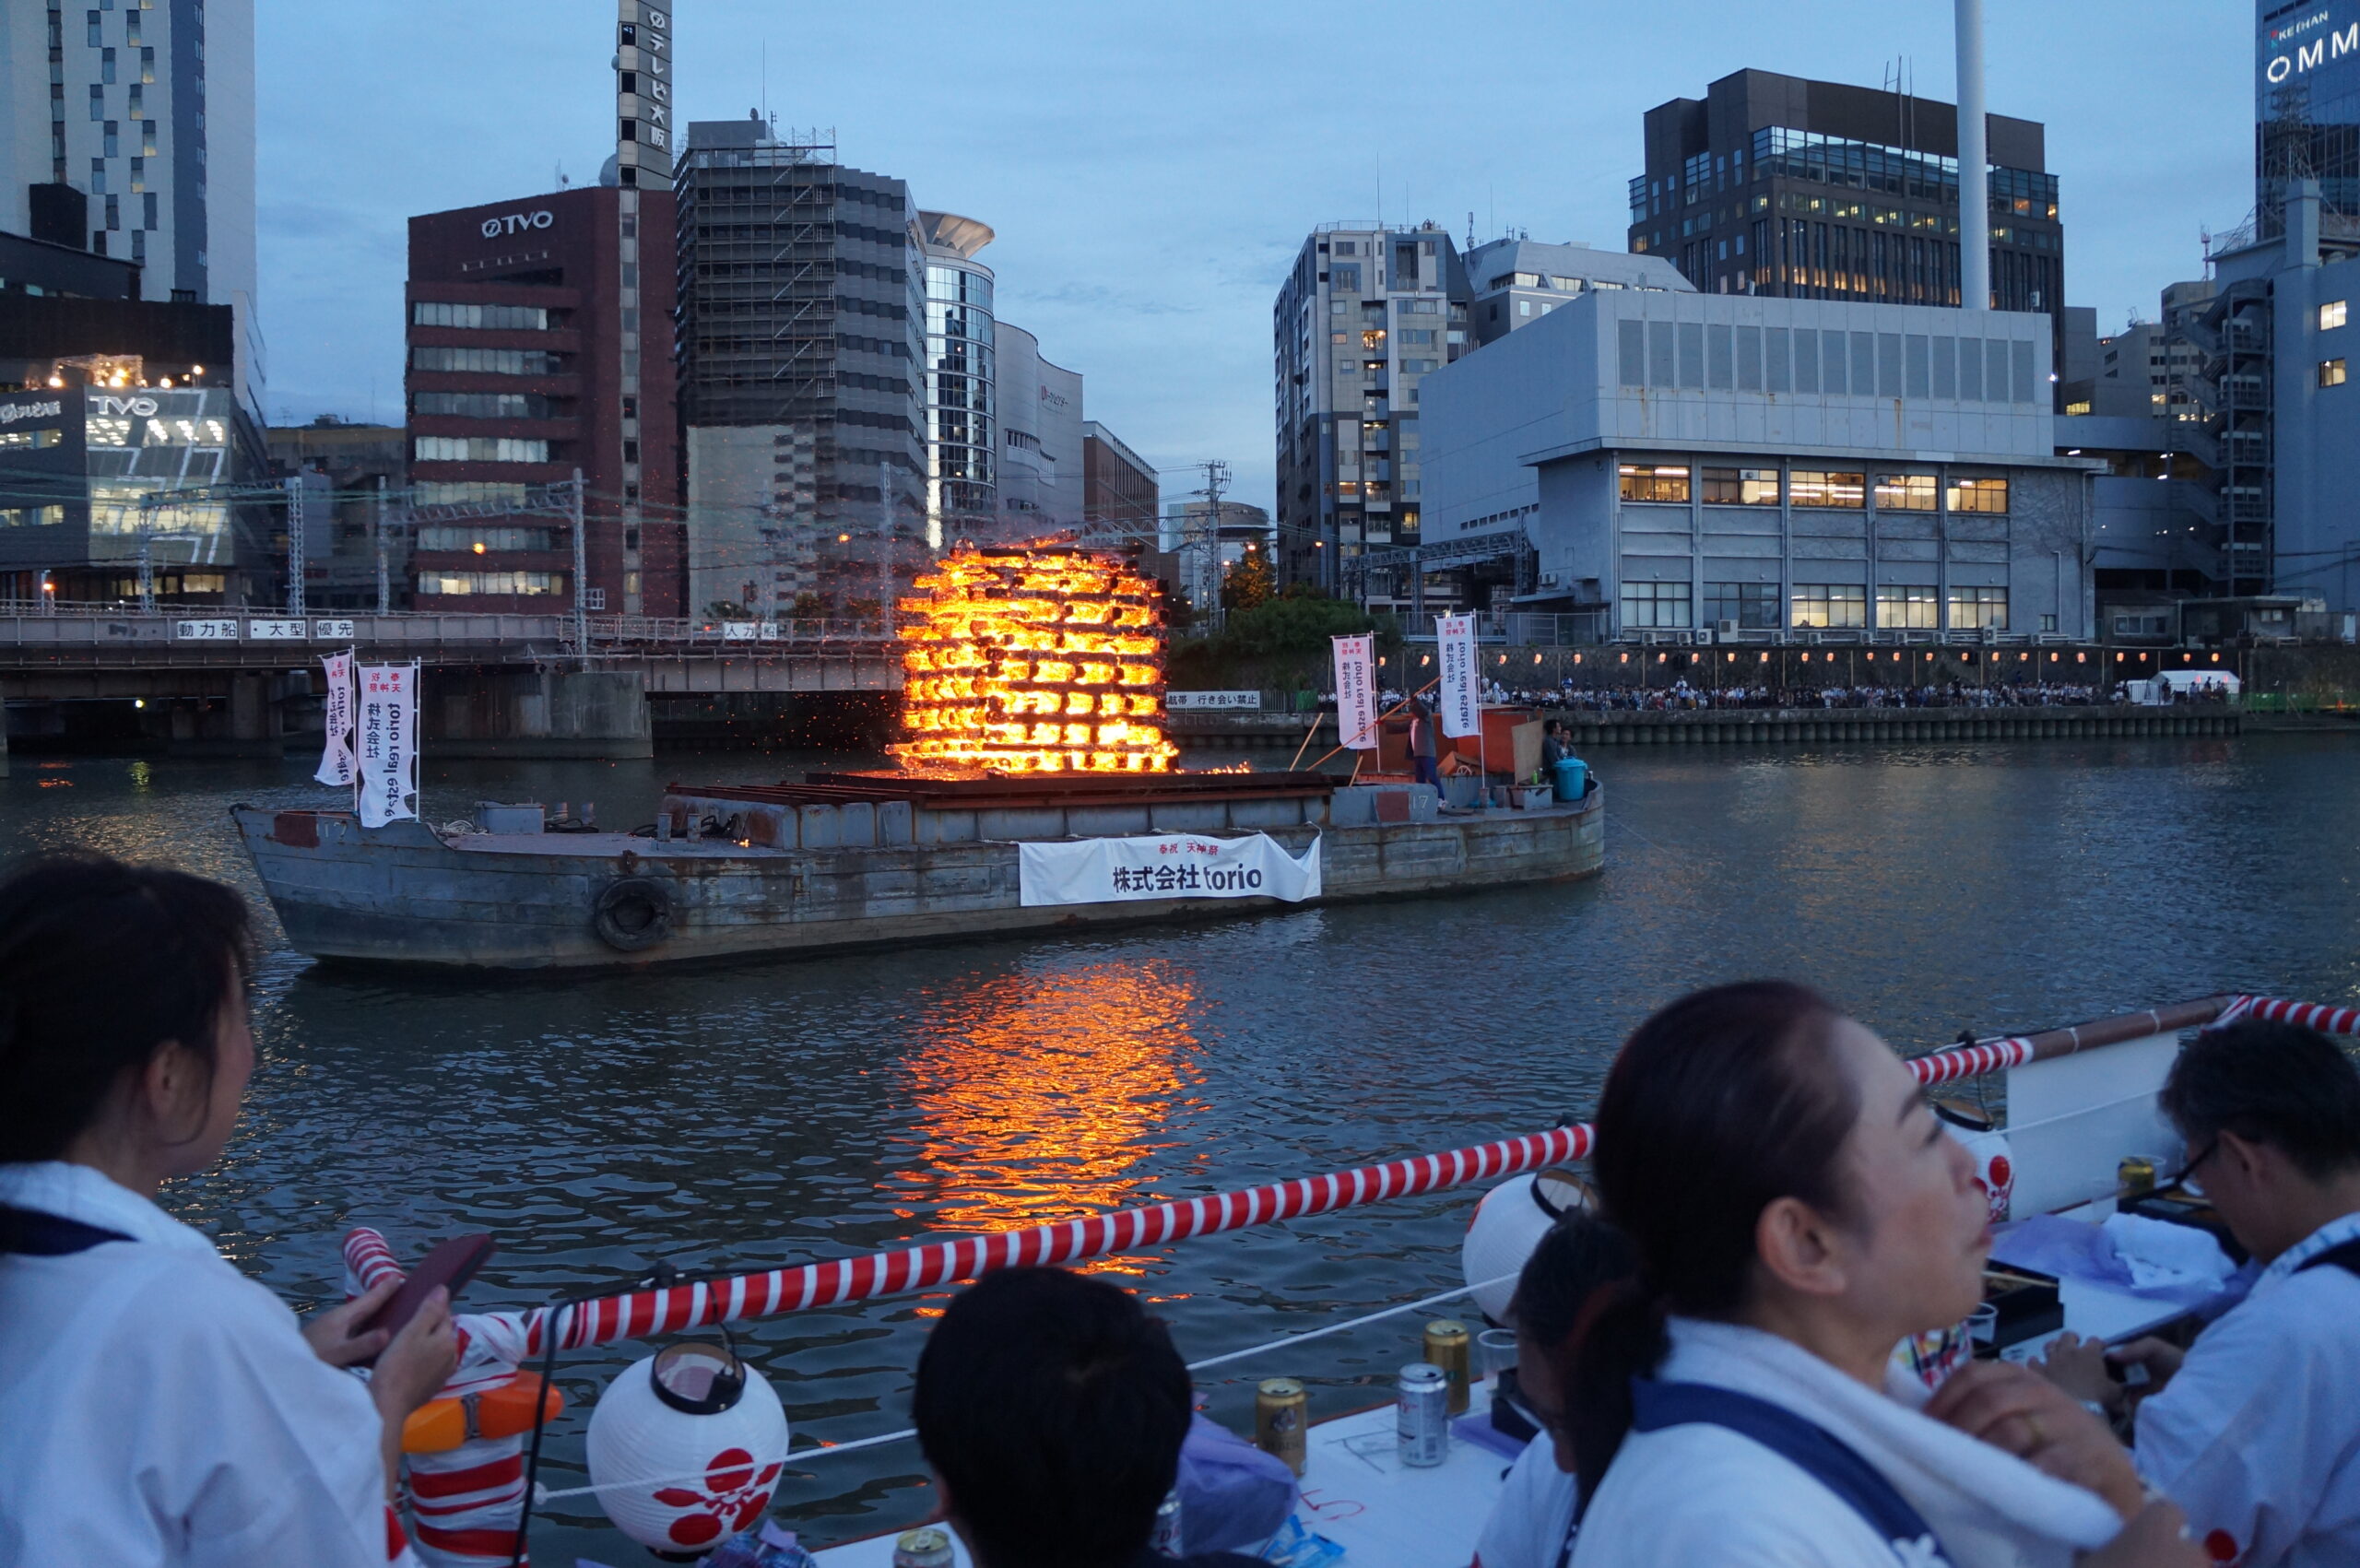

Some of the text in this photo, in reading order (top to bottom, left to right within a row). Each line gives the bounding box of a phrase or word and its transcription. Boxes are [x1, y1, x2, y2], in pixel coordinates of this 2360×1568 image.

[2267, 22, 2358, 83] OMM
[650, 33, 666, 148] テレビ大阪
[501, 210, 553, 234] TVO
[88, 395, 158, 417] TVO
[1198, 694, 1257, 705] 行き会い禁止
[1186, 842, 1220, 856] 天神祭
